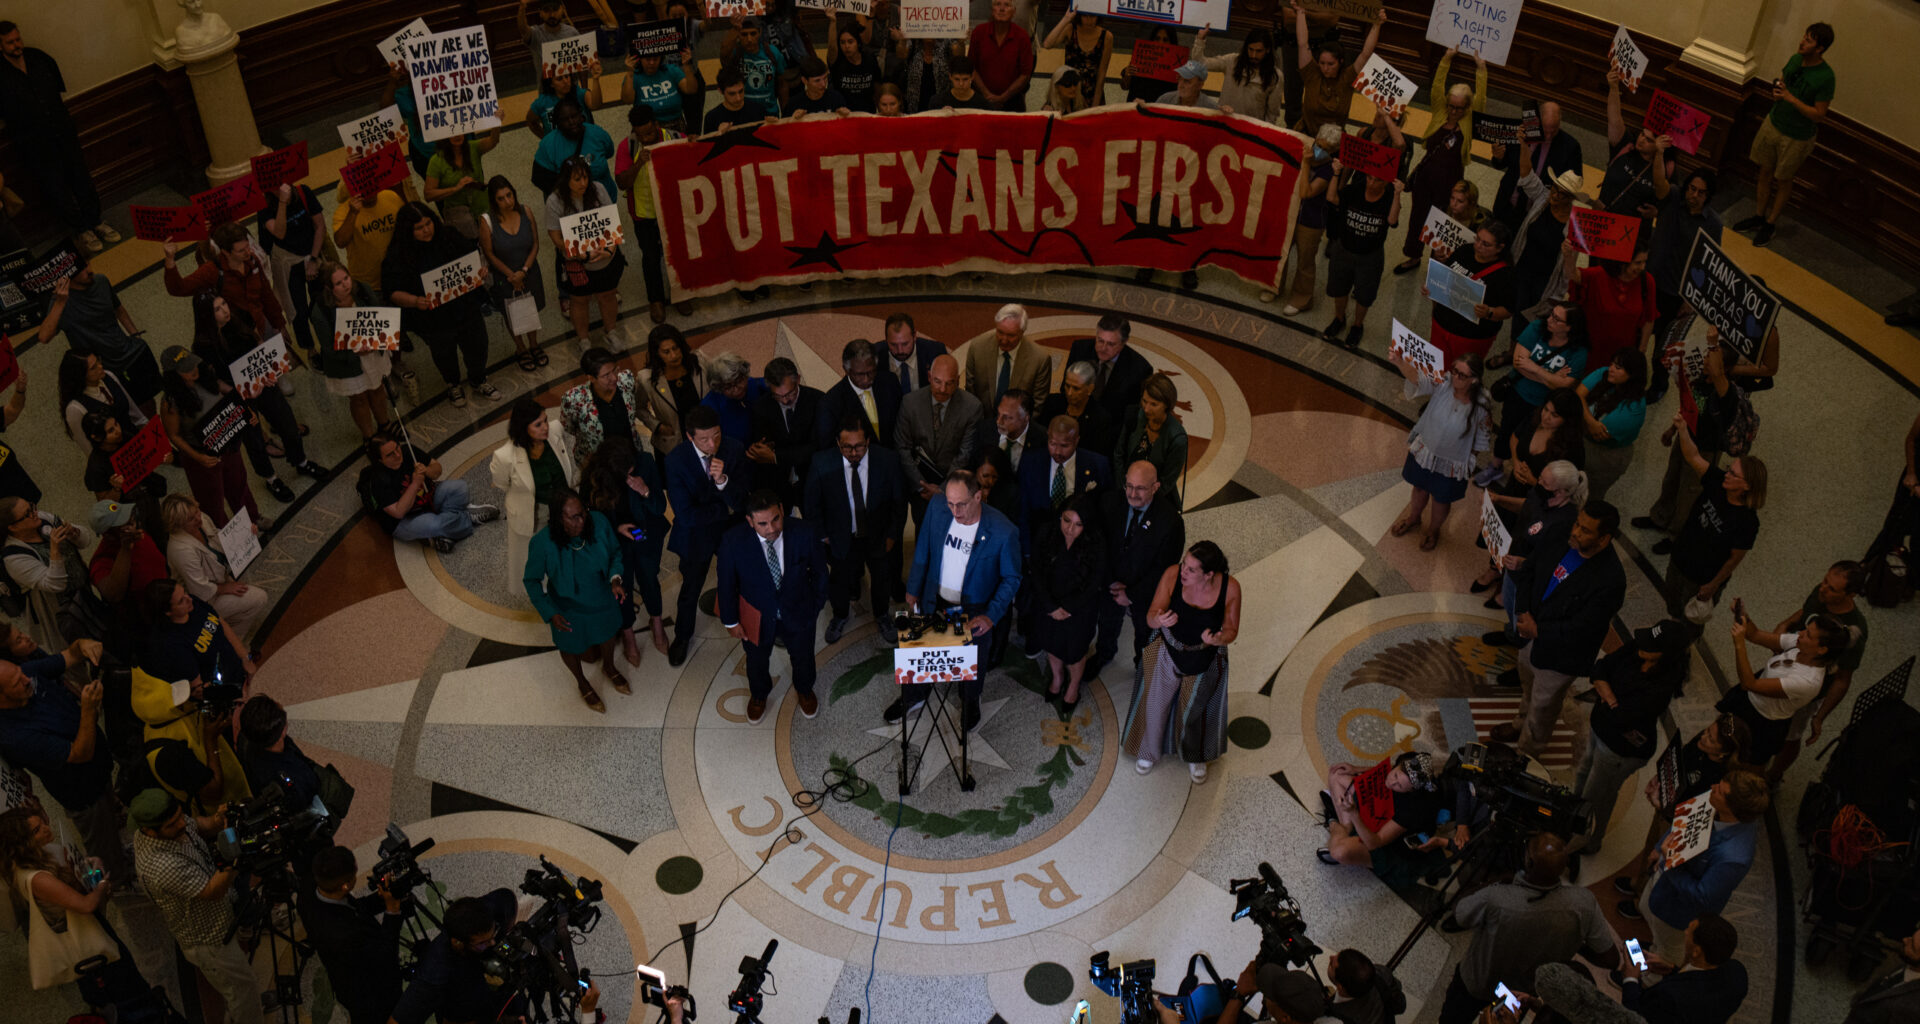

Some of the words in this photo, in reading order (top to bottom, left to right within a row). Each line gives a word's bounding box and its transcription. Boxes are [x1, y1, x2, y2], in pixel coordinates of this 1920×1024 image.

[850, 1, 868, 13] YOU
[903, 6, 963, 21] TAKEOVER!
[661, 26, 677, 34] THE
[1449, 12, 1501, 40] RIGHTS
[396, 29, 412, 44] PUT
[408, 40, 437, 59] WHY
[441, 37, 463, 54] ARE
[466, 32, 484, 47] WE
[561, 39, 580, 50] PUT
[1460, 34, 1487, 53] ACT
[552, 44, 590, 59] TEXANS
[638, 44, 679, 55] TAKEOVER
[411, 54, 459, 78] DRAWING
[462, 49, 490, 68] MAPS
[557, 54, 583, 65] FIRST
[421, 75, 448, 95] FOR
[451, 67, 489, 89] TRUMP
[1371, 68, 1404, 97] TEXANS
[1383, 68, 1401, 83] PUT
[425, 87, 474, 111] INSTEAD
[477, 84, 492, 100] OF
[1371, 79, 1395, 99] FIRST
[360, 116, 380, 130] PUT
[424, 111, 449, 130] FOR
[450, 100, 499, 124] TEXANS
[352, 119, 394, 141] TEXANS
[362, 129, 389, 146] FIRST
[677, 156, 800, 260] PUT
[819, 144, 1079, 242] TEXANS
[1101, 138, 1284, 241] FIRST
[361, 213, 394, 235] MOVE
[571, 218, 611, 234] TEXANS
[579, 212, 599, 224] PUT
[1444, 219, 1462, 234] PUT
[579, 227, 606, 241] FIRST
[433, 265, 473, 287] TEXANS
[442, 261, 461, 276] PUT
[33, 265, 78, 293] TAKEVER
[441, 274, 468, 292] FIRST
[1701, 242, 1741, 296] THANK
[1743, 283, 1768, 320] YOU
[1706, 277, 1744, 325] TEXAS
[345, 320, 390, 329] TEXANS
[356, 311, 379, 320] PUT
[1685, 281, 1753, 355] DEMOCRATS
[351, 328, 383, 337] FIRST
[1408, 333, 1425, 349] PUT
[248, 347, 265, 364] PUT
[1399, 334, 1436, 363] TEXANS
[240, 349, 278, 377] TEXANS
[249, 360, 274, 381] FIRST
[202, 415, 223, 437] FIGHT
[222, 401, 236, 417] THE
[213, 419, 247, 453] TAKEOVER
[908, 657, 965, 666] TEXANS
[922, 650, 950, 658] PUT
[917, 665, 955, 673] FIRST
[1689, 801, 1706, 849] TEXANS
[1701, 808, 1713, 832] PUT
[727, 796, 1082, 931] REPUBLIC
